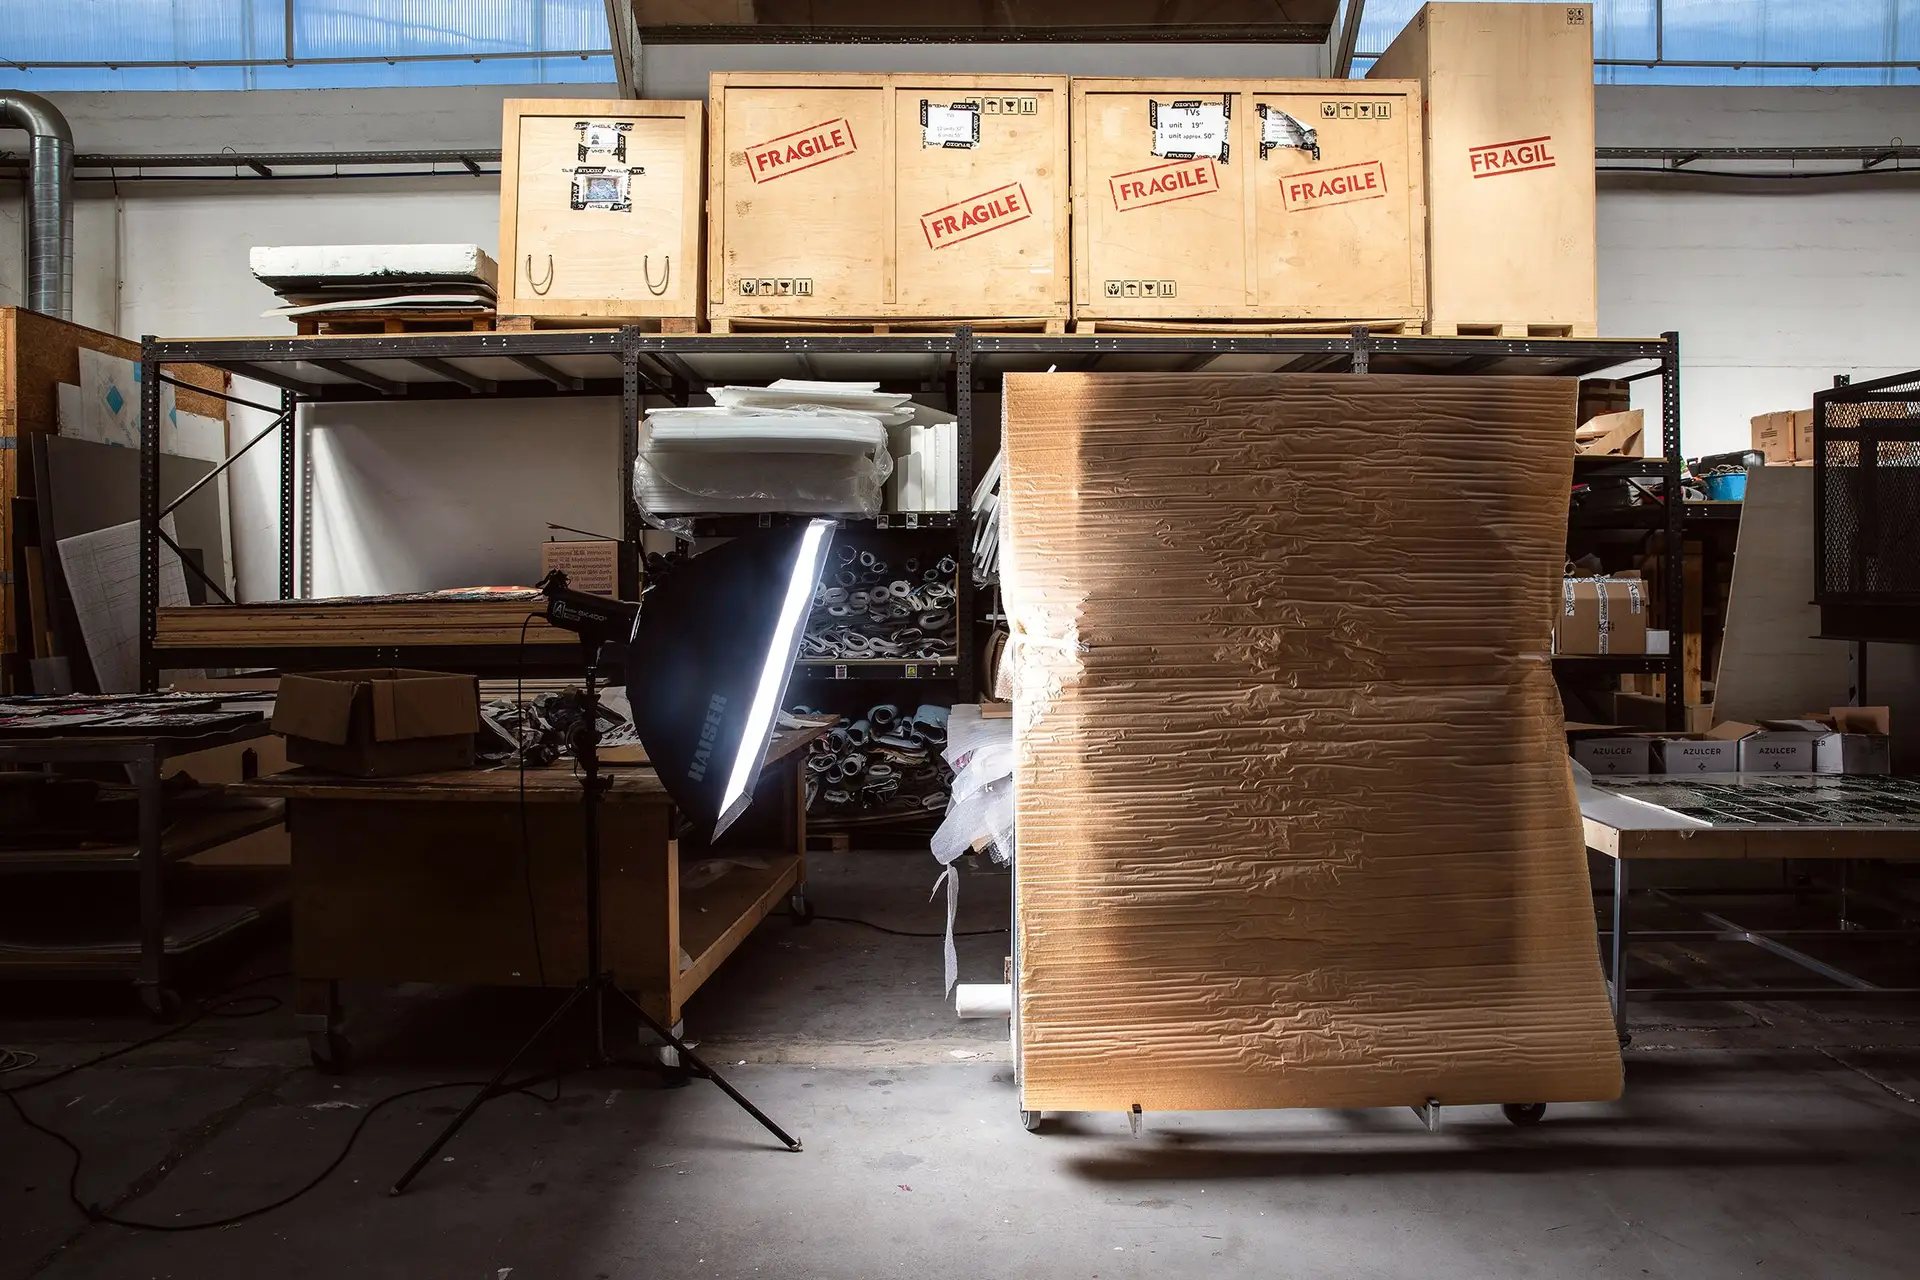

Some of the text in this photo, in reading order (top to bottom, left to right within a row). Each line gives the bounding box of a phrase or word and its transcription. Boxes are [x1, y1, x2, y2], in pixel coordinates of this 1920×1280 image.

[1168, 121, 1183, 129] unit
[1184, 108, 1201, 116] TVs
[755, 129, 845, 172] FRAGILE
[1470, 144, 1554, 173] FRAGIL
[1120, 167, 1208, 201] FRAGILE
[1290, 171, 1377, 202] FRAGILE
[932, 194, 1021, 238] FRAGILE
